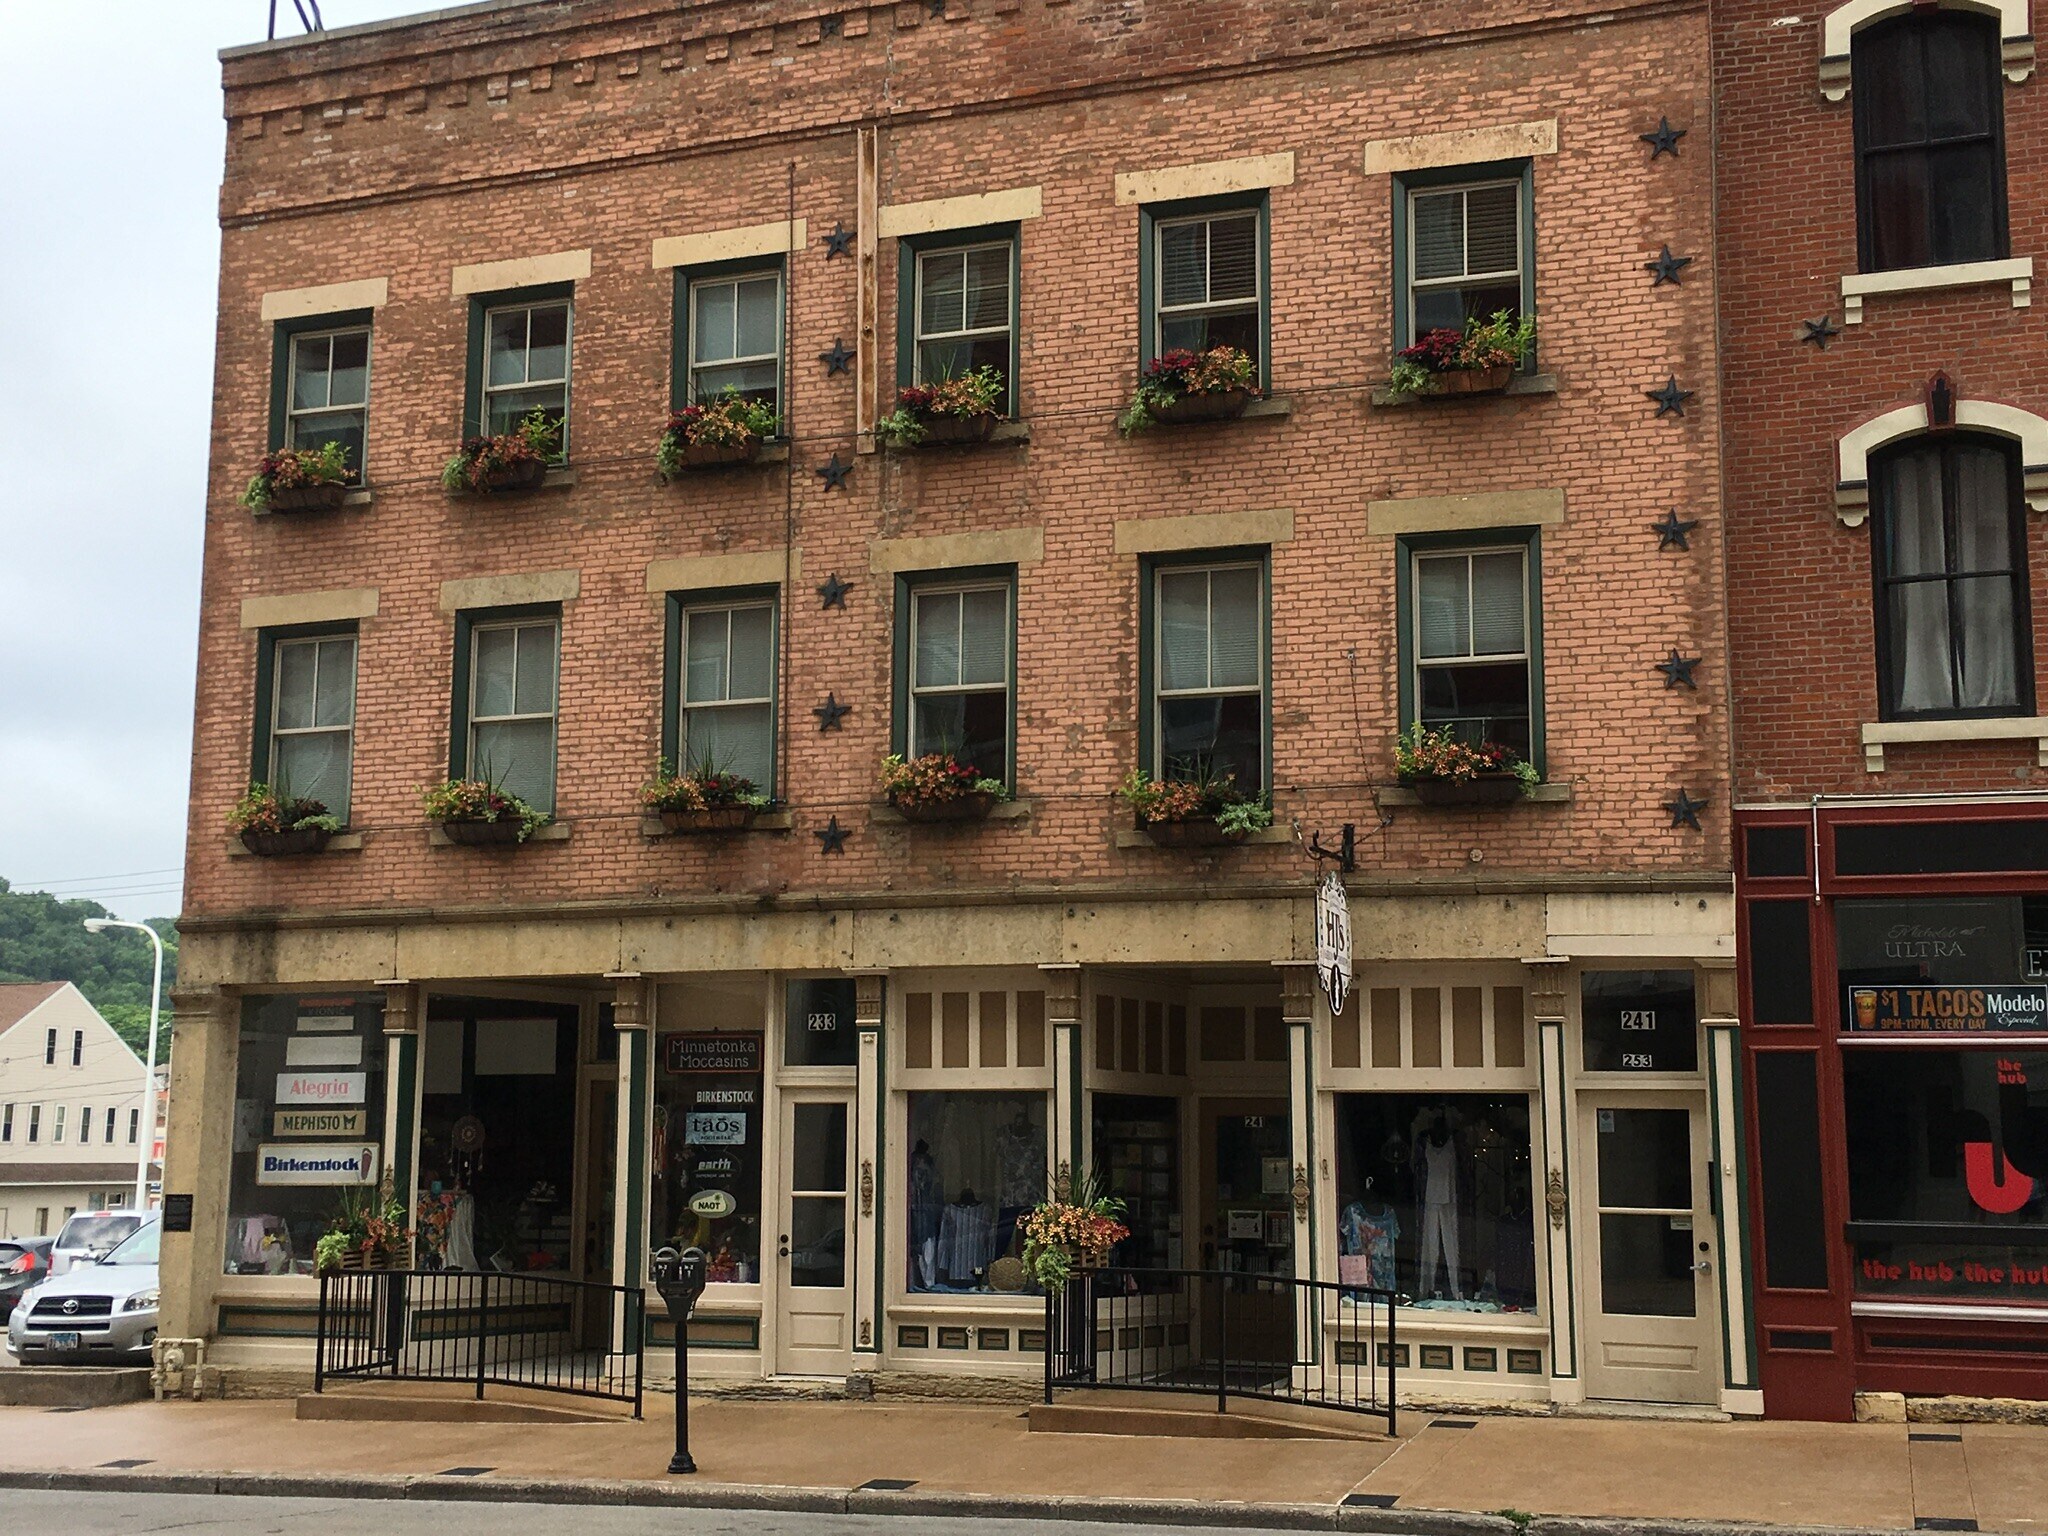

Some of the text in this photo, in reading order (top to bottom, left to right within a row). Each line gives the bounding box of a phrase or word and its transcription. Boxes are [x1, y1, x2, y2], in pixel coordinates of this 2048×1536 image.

[1884, 941, 1966, 959] ULTRA
[1881, 989, 1985, 1018] $1 TACOS
[1987, 993, 2045, 1014] Modelo
[809, 1014, 835, 1030] 233
[1622, 1011, 1655, 1029] 241
[1934, 1018, 1966, 1031] EVERY
[1968, 1018, 1988, 1030] DAY
[672, 1040, 756, 1053] Minnetonka
[680, 1055, 749, 1068] Moccasins
[1623, 1054, 1652, 1067] 253
[1996, 1058, 2022, 1072] the
[1997, 1071, 2027, 1085] hub
[290, 1079, 349, 1098] Alegria
[696, 1090, 754, 1103] BIRKENSTOCK
[283, 1115, 340, 1130] MEPHISTO
[264, 1156, 360, 1172] Birkenstock
[698, 1158, 732, 1171] earth
[698, 1202, 721, 1210] NAOT
[1862, 1258, 1902, 1281] the
[1908, 1259, 1954, 1282] hub
[1964, 1261, 2005, 1283] the
